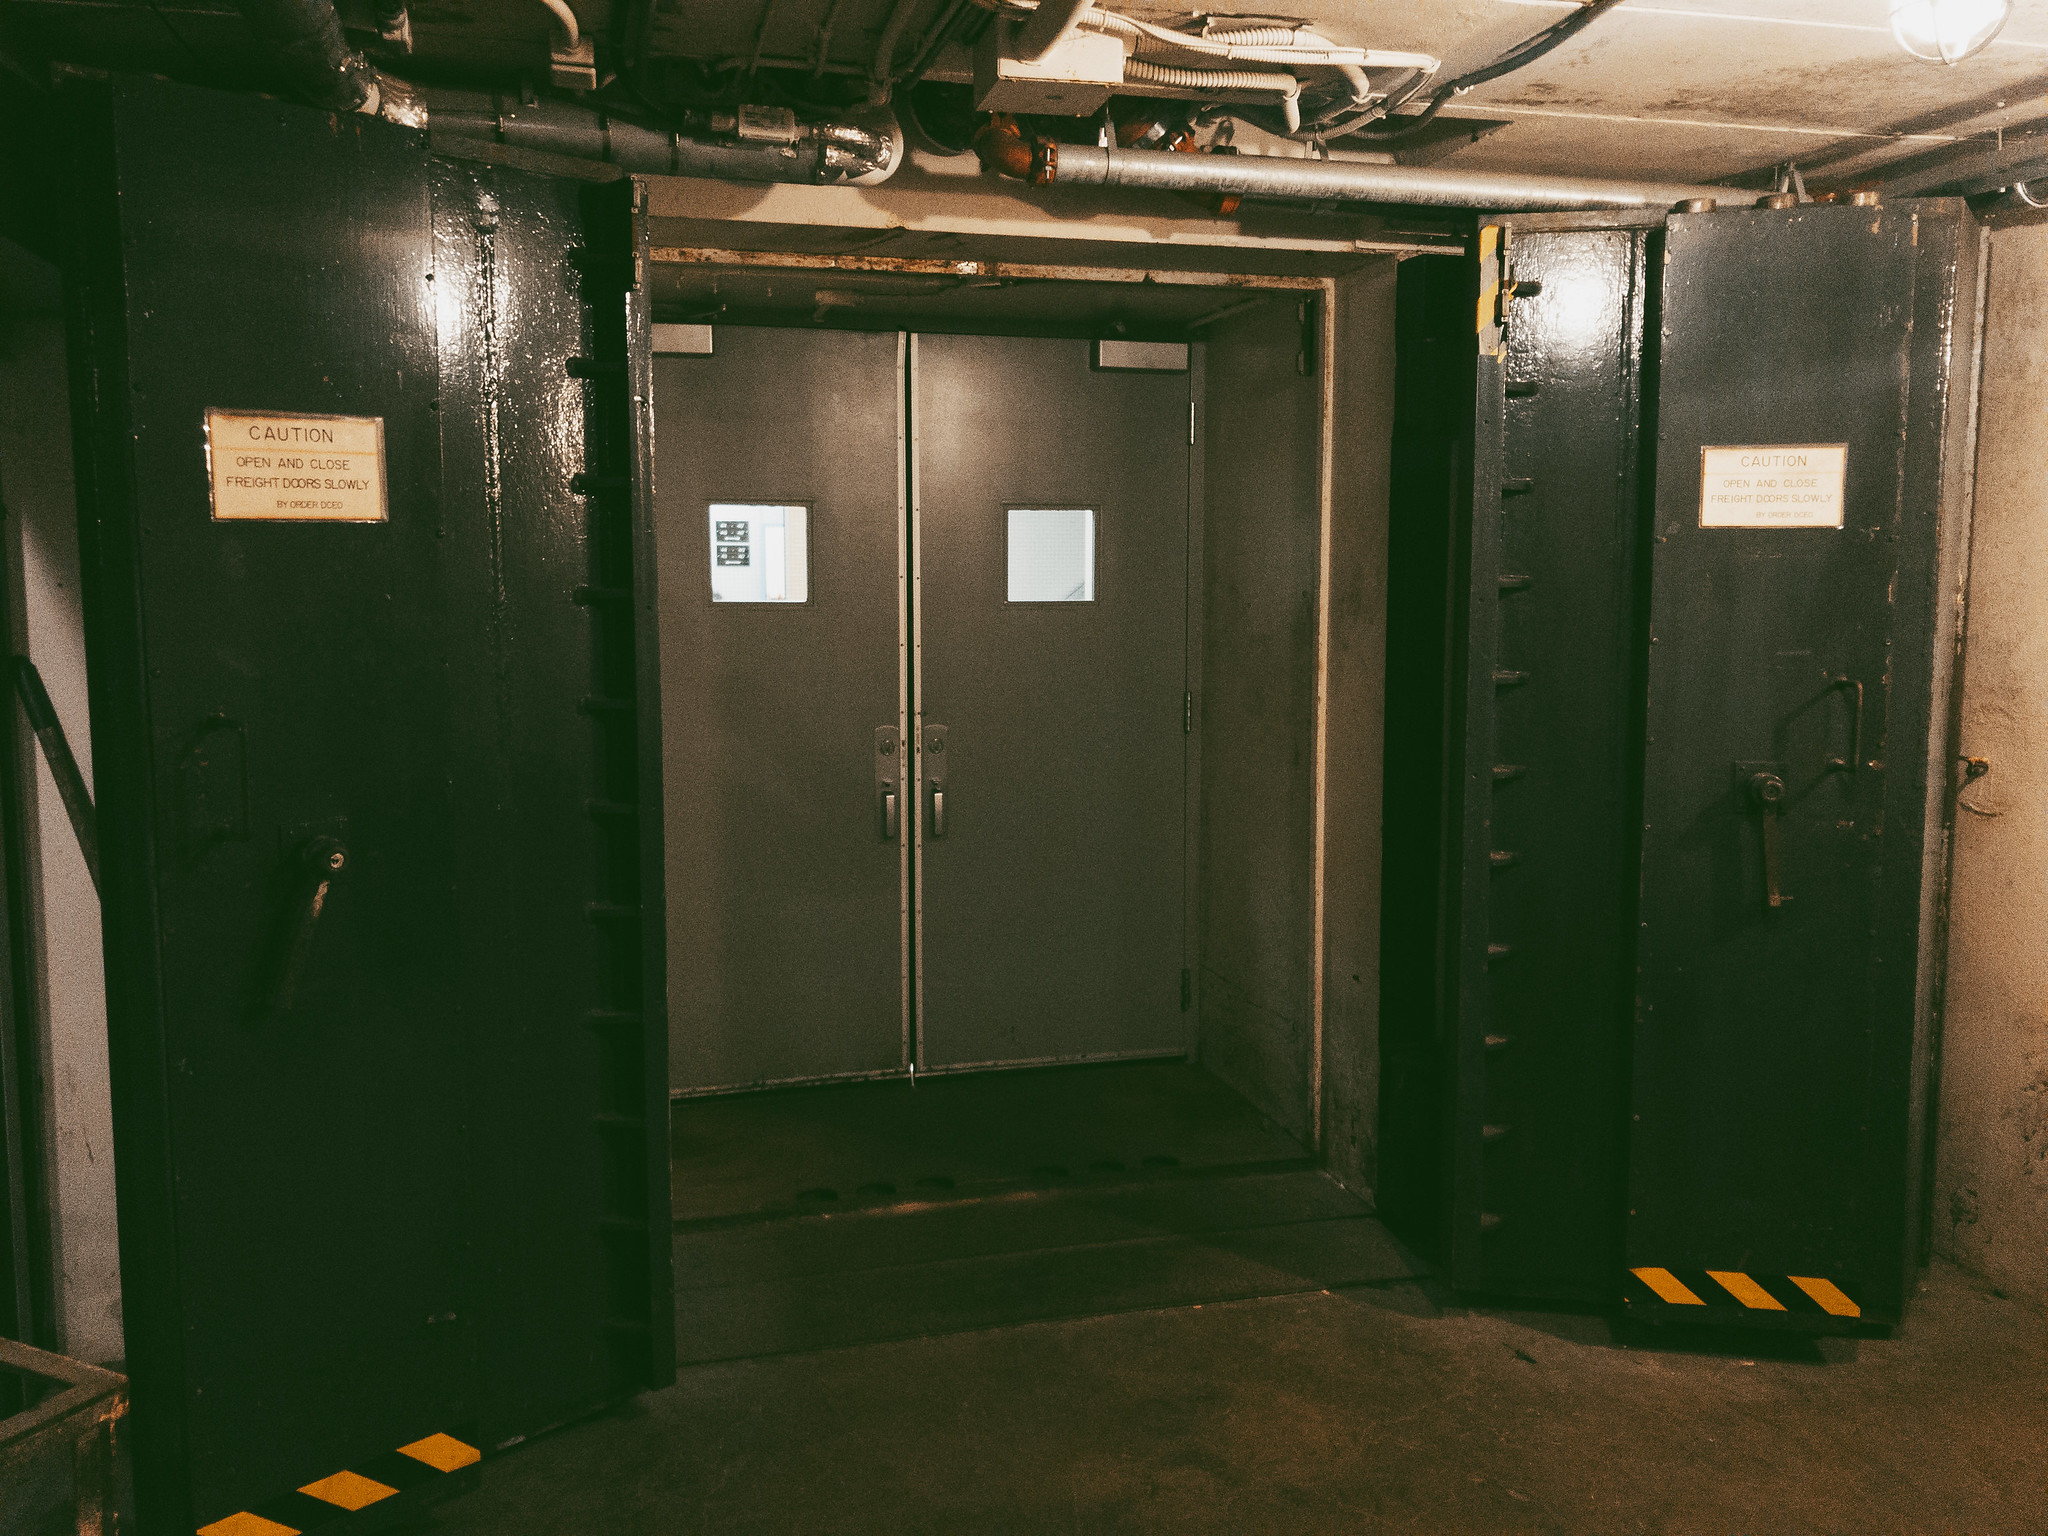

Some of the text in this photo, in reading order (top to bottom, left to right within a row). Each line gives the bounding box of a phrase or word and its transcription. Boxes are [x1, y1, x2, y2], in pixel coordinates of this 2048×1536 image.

[250, 425, 334, 443] CAUTION
[236, 456, 350, 471] OPEN AND CLOSE
[1741, 455, 1807, 468] CAUTION
[226, 476, 370, 490] FREIGHT DOORS SLOWLY
[1723, 478, 1818, 488] OPEN AND CLOSE
[276, 500, 288, 509] BY
[290, 500, 318, 509] ORDER
[1711, 494, 1833, 504] FREIGHT DOORS SLOWLY
